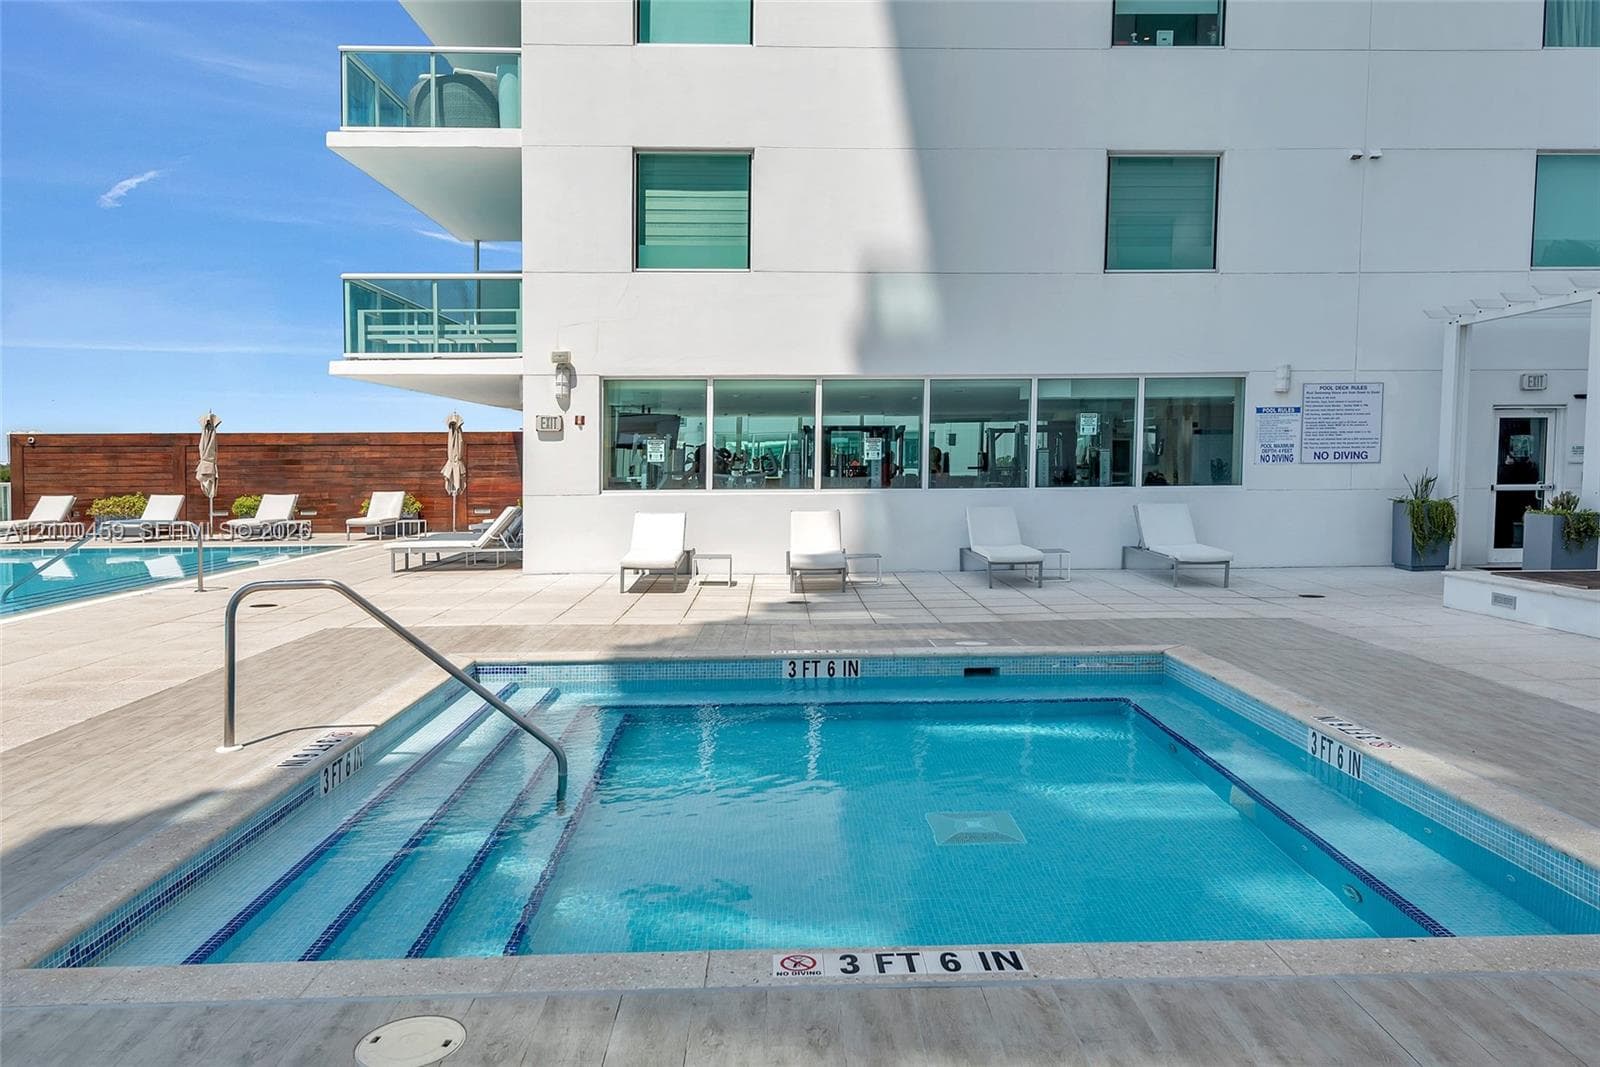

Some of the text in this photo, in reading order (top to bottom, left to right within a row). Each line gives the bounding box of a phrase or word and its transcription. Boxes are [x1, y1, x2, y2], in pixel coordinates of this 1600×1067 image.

[1528, 375, 1544, 388] EXIT
[540, 416, 558, 429] EXIT
[1260, 454, 1294, 463] NO DIVING
[1313, 451, 1369, 460] NO DIVING
[788, 660, 859, 678] 3 FT 6 IN
[1311, 731, 1361, 779] 3 FT 6 IN
[323, 744, 363, 794] 3 FT 6 IN
[839, 950, 1024, 974] 3 FT 6 IN
